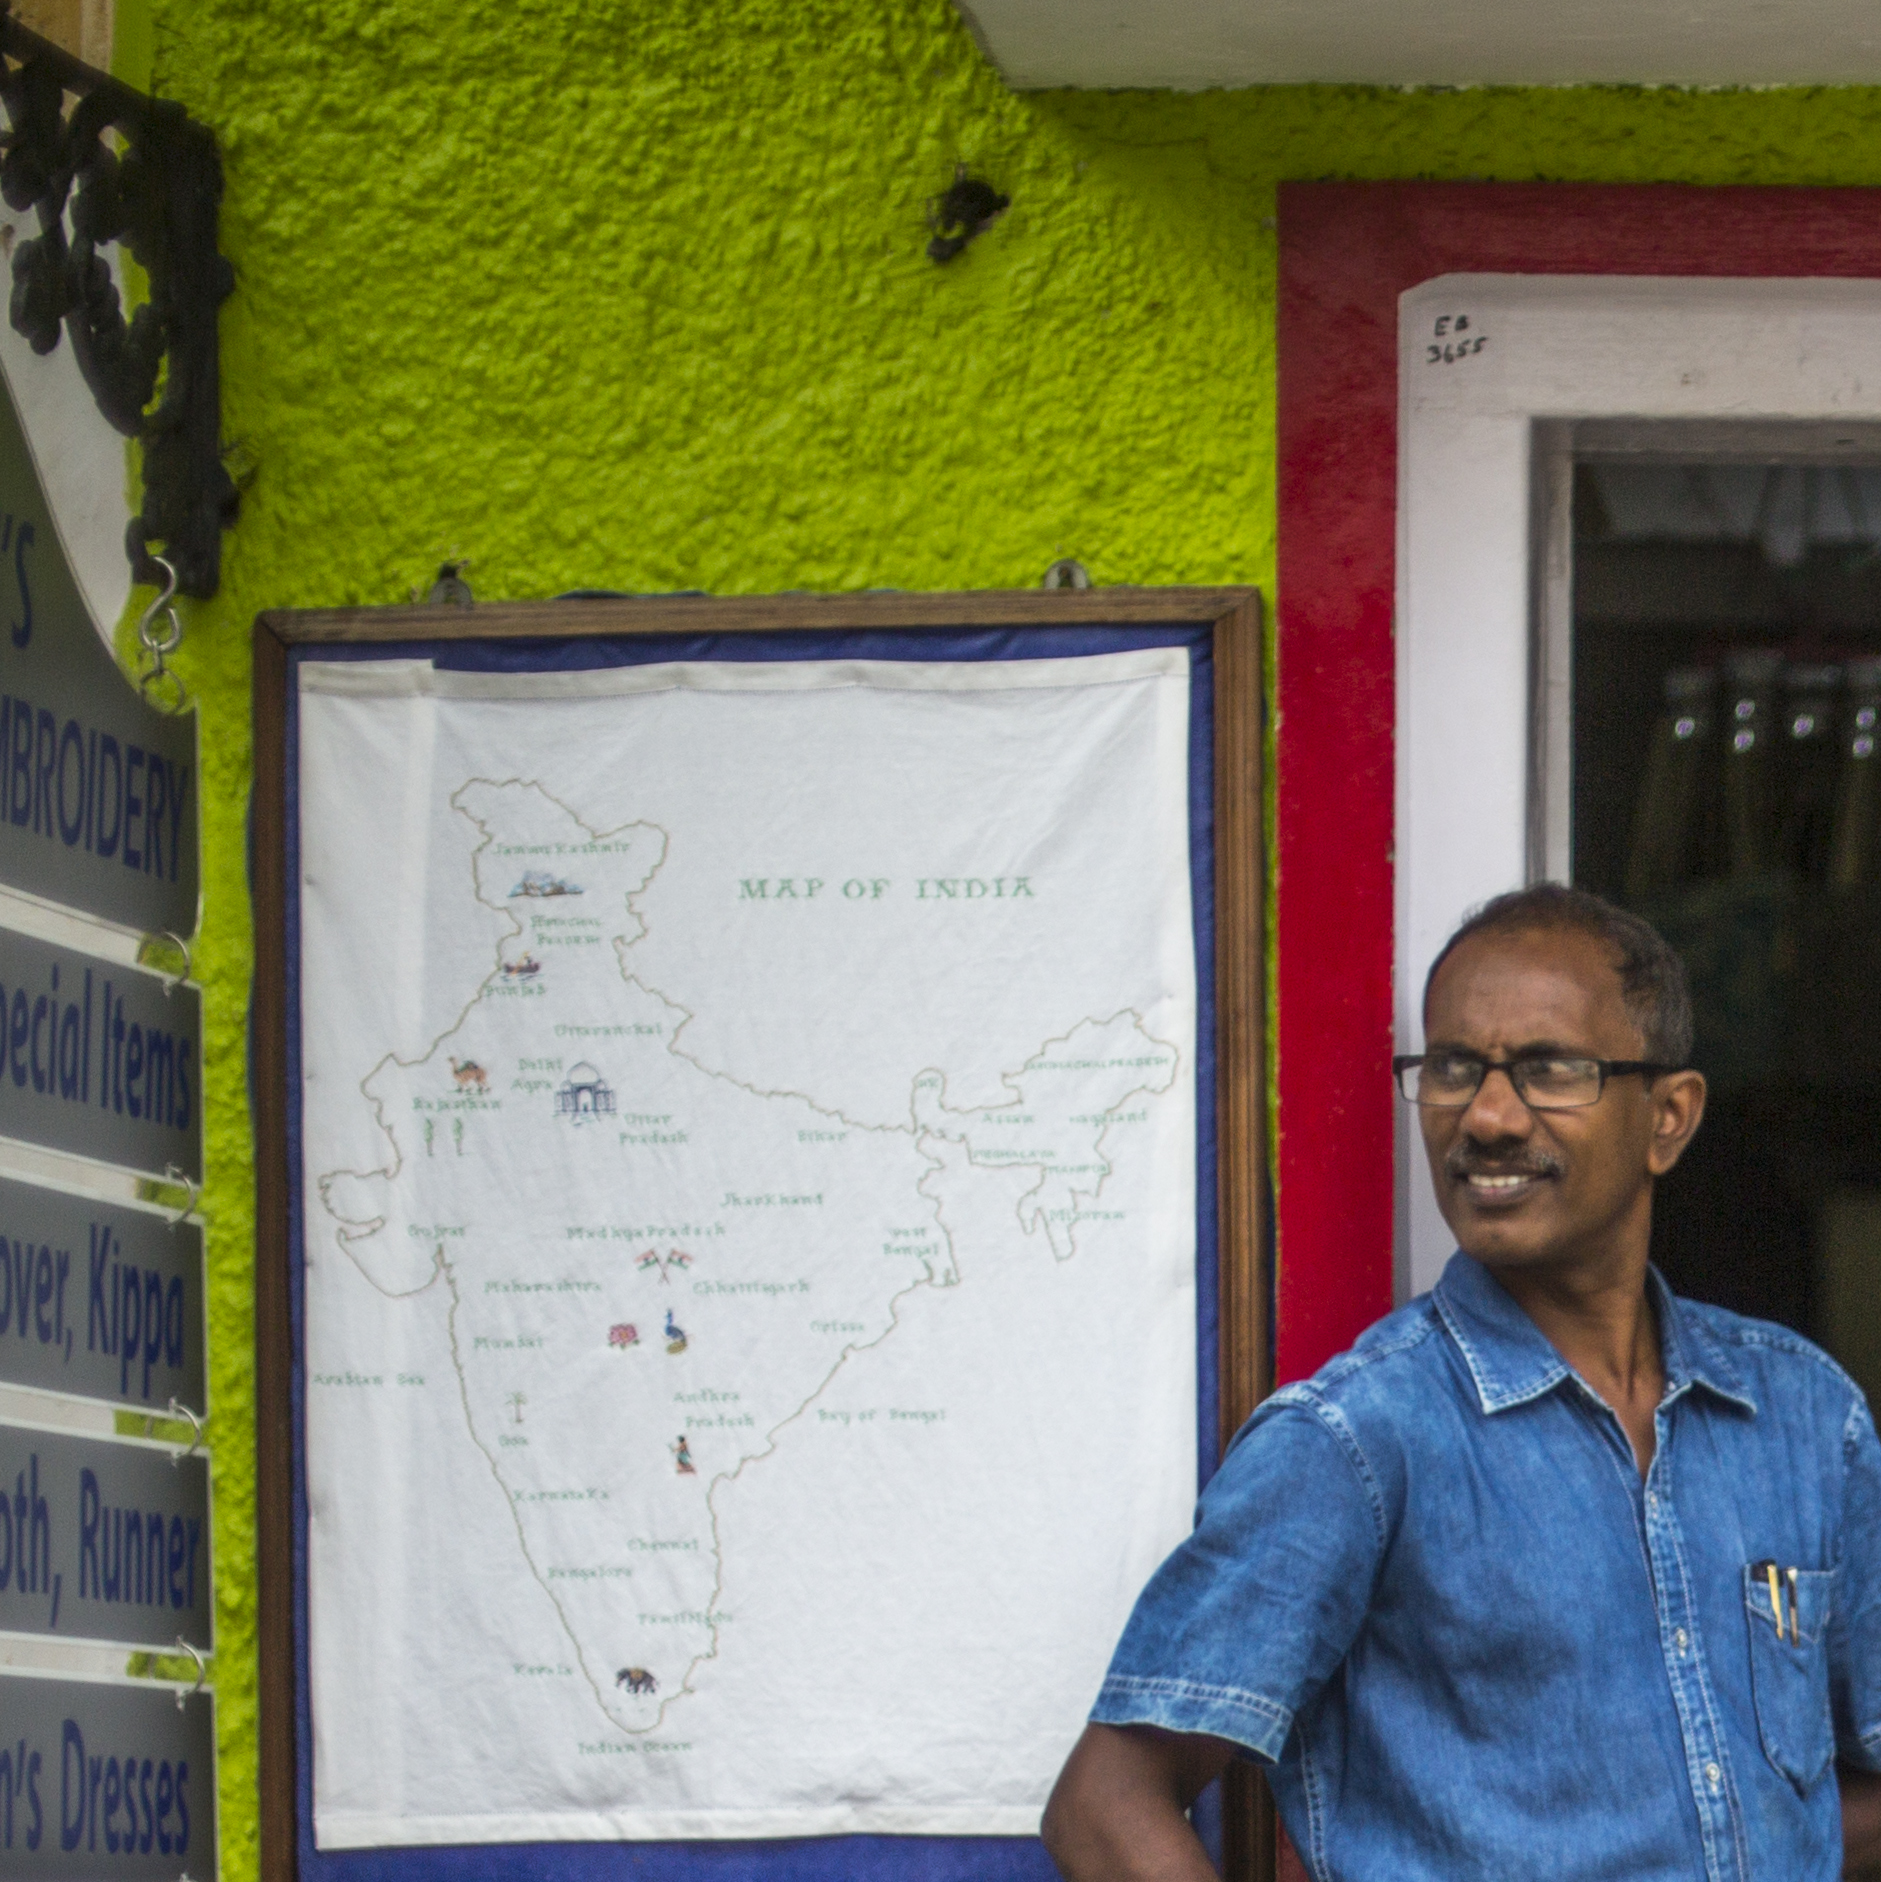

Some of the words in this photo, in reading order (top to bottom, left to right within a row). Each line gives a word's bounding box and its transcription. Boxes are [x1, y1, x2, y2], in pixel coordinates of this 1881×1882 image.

[738, 877, 825, 900] MAP
[840, 877, 891, 900] OF
[915, 876, 1036, 899] INDIA
[101, 980, 191, 1132] Items
[518, 1058, 563, 1072] Delhi
[510, 1078, 552, 1093] Agra
[411, 1097, 502, 1111] Rajasthan
[882, 1242, 939, 1258] Bengal
[88, 1221, 184, 1398] Kippa
[472, 1336, 544, 1349] Mumbai
[313, 1370, 384, 1386] Arabian
[396, 1372, 425, 1386] Sea
[673, 1388, 740, 1403] Andhra
[685, 1414, 755, 1429] Pradesh
[818, 1409, 851, 1425] Bay
[858, 1408, 877, 1421] of
[888, 1409, 947, 1425] Bengal
[79, 1466, 200, 1609] Runner
[627, 1538, 699, 1552] Chennai
[512, 1663, 574, 1677] Kerala
[577, 1741, 636, 1755] Indian
[61, 1718, 190, 1856] Dresses
